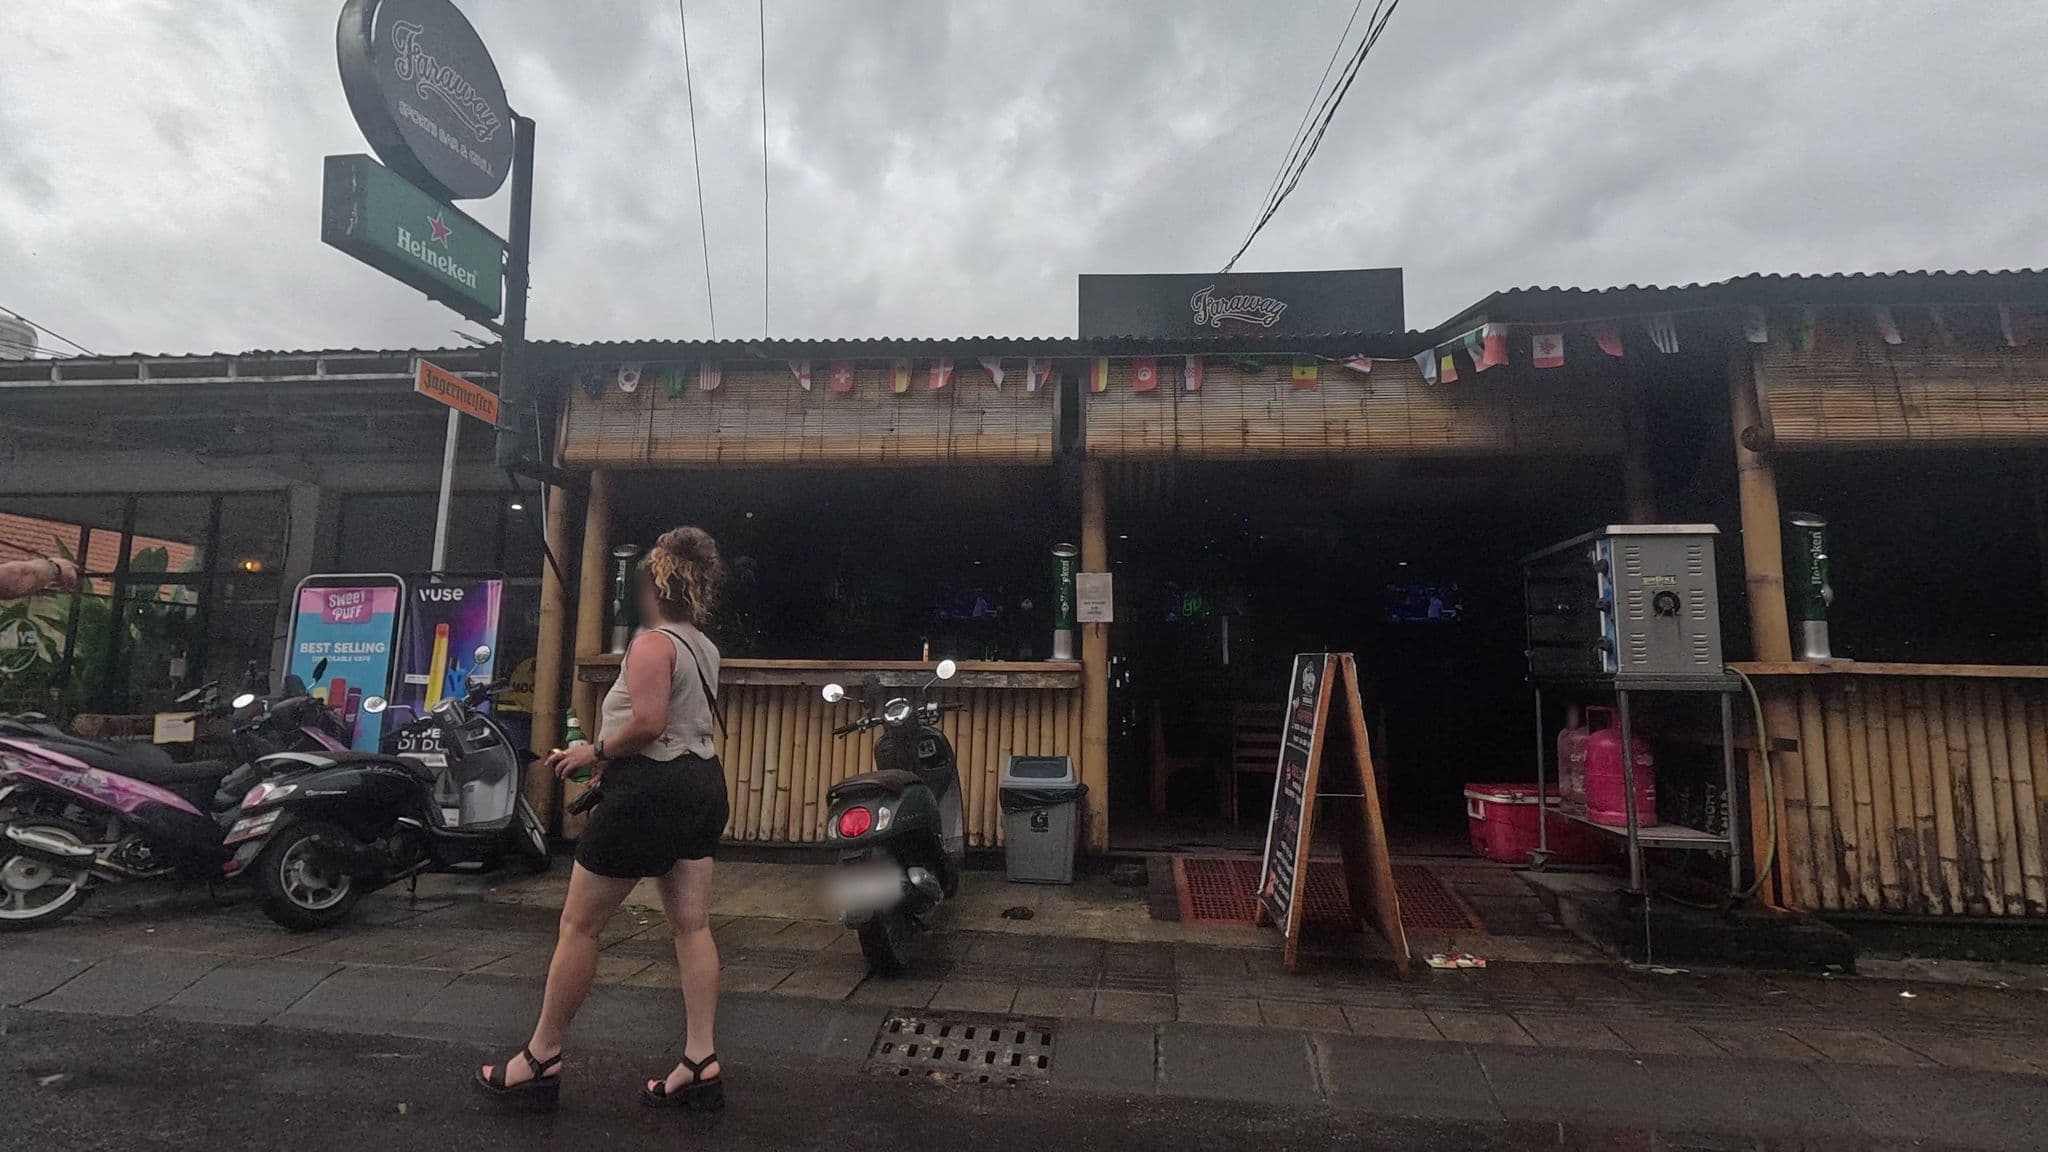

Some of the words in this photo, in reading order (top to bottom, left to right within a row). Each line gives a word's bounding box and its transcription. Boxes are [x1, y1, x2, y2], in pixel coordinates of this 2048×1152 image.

[391, 20, 501, 142] Faraway
[397, 227, 478, 289] Heineken
[1190, 284, 1287, 327] Faraway
[419, 587, 464, 602] vuse
[332, 604, 363, 621] PUFF
[300, 642, 332, 653] BEST
[333, 642, 385, 653] SELLING
